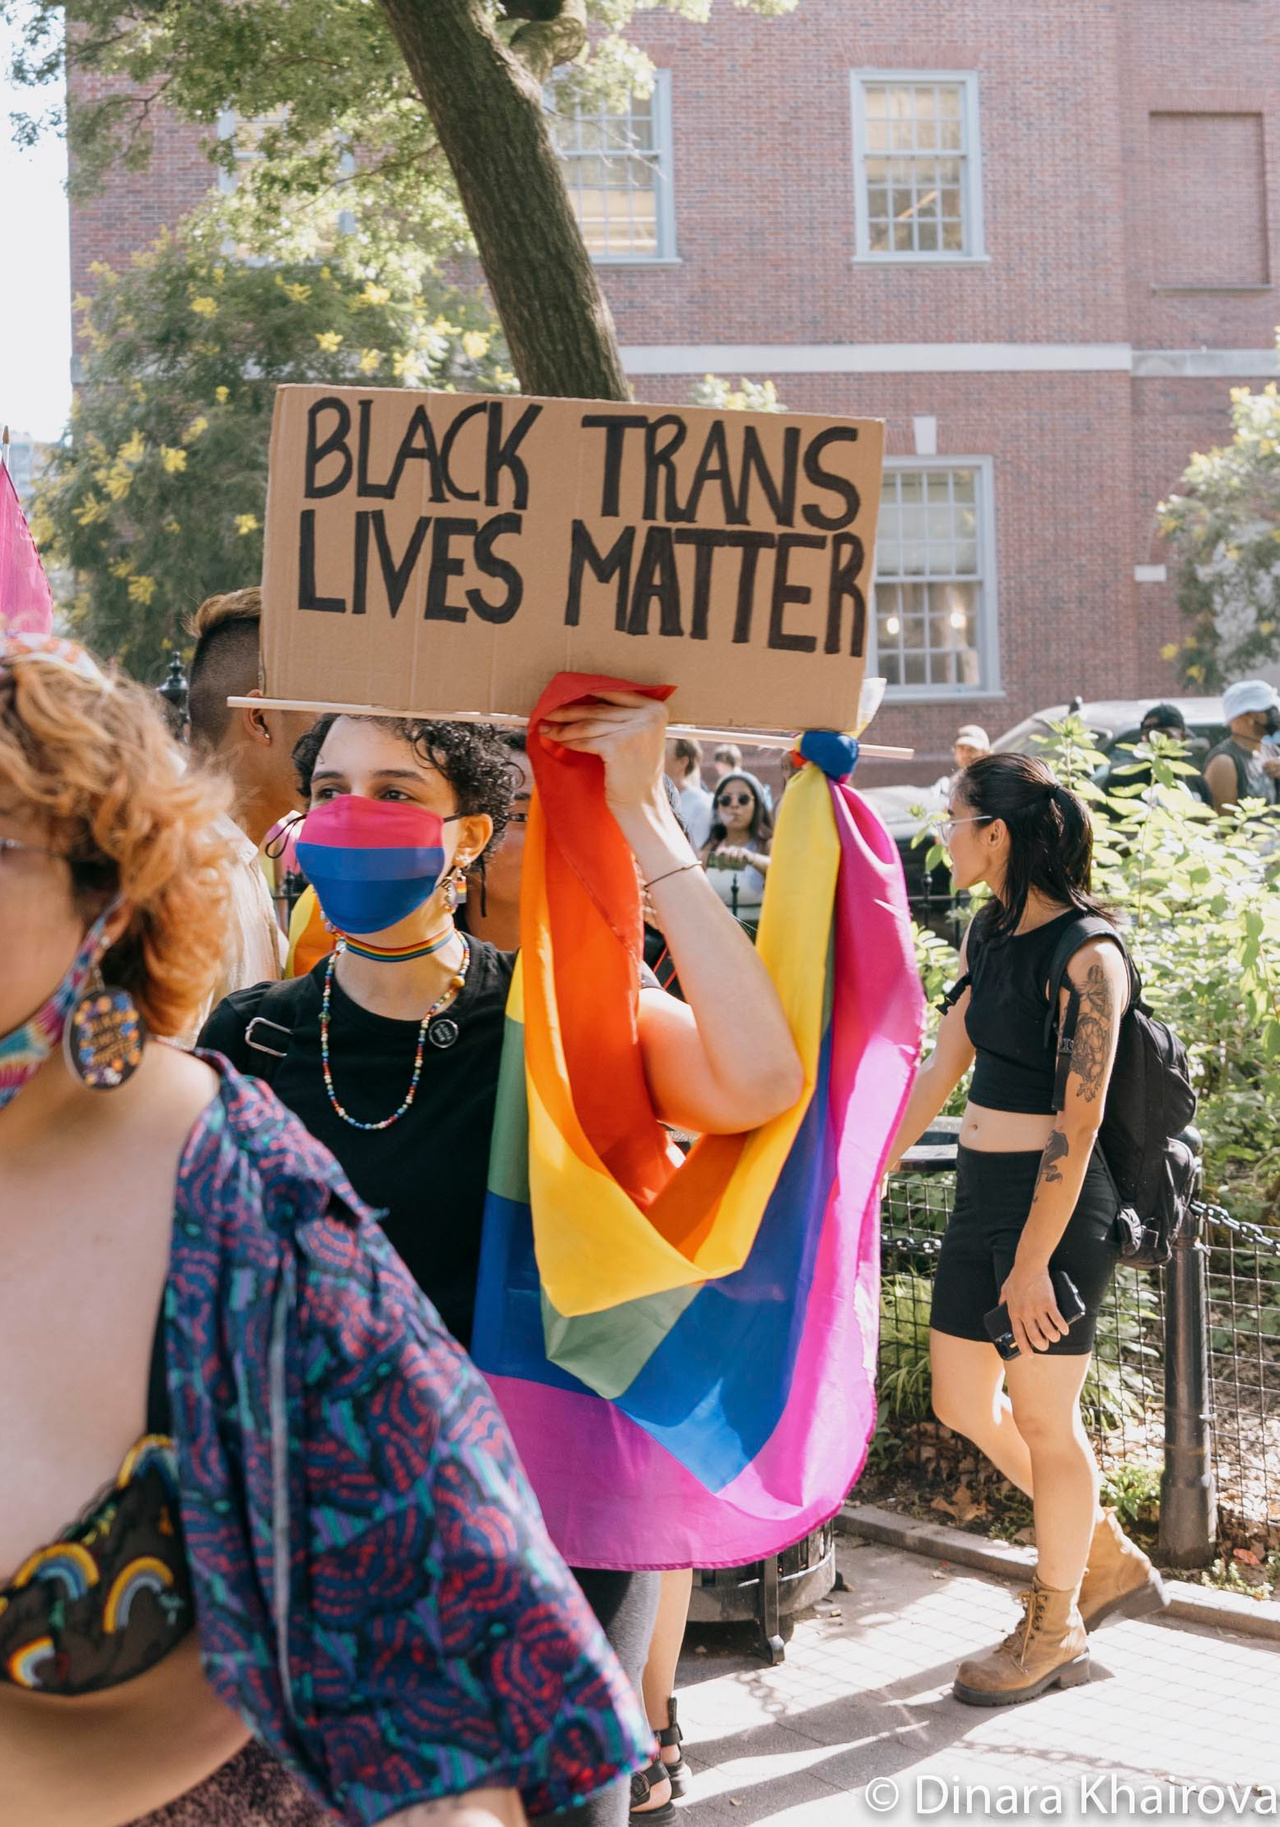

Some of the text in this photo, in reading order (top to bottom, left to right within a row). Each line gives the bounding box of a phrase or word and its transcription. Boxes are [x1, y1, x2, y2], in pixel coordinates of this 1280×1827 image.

[304, 396, 862, 532] BLACK TRANS
[298, 507, 867, 658] LIVES MATTER
